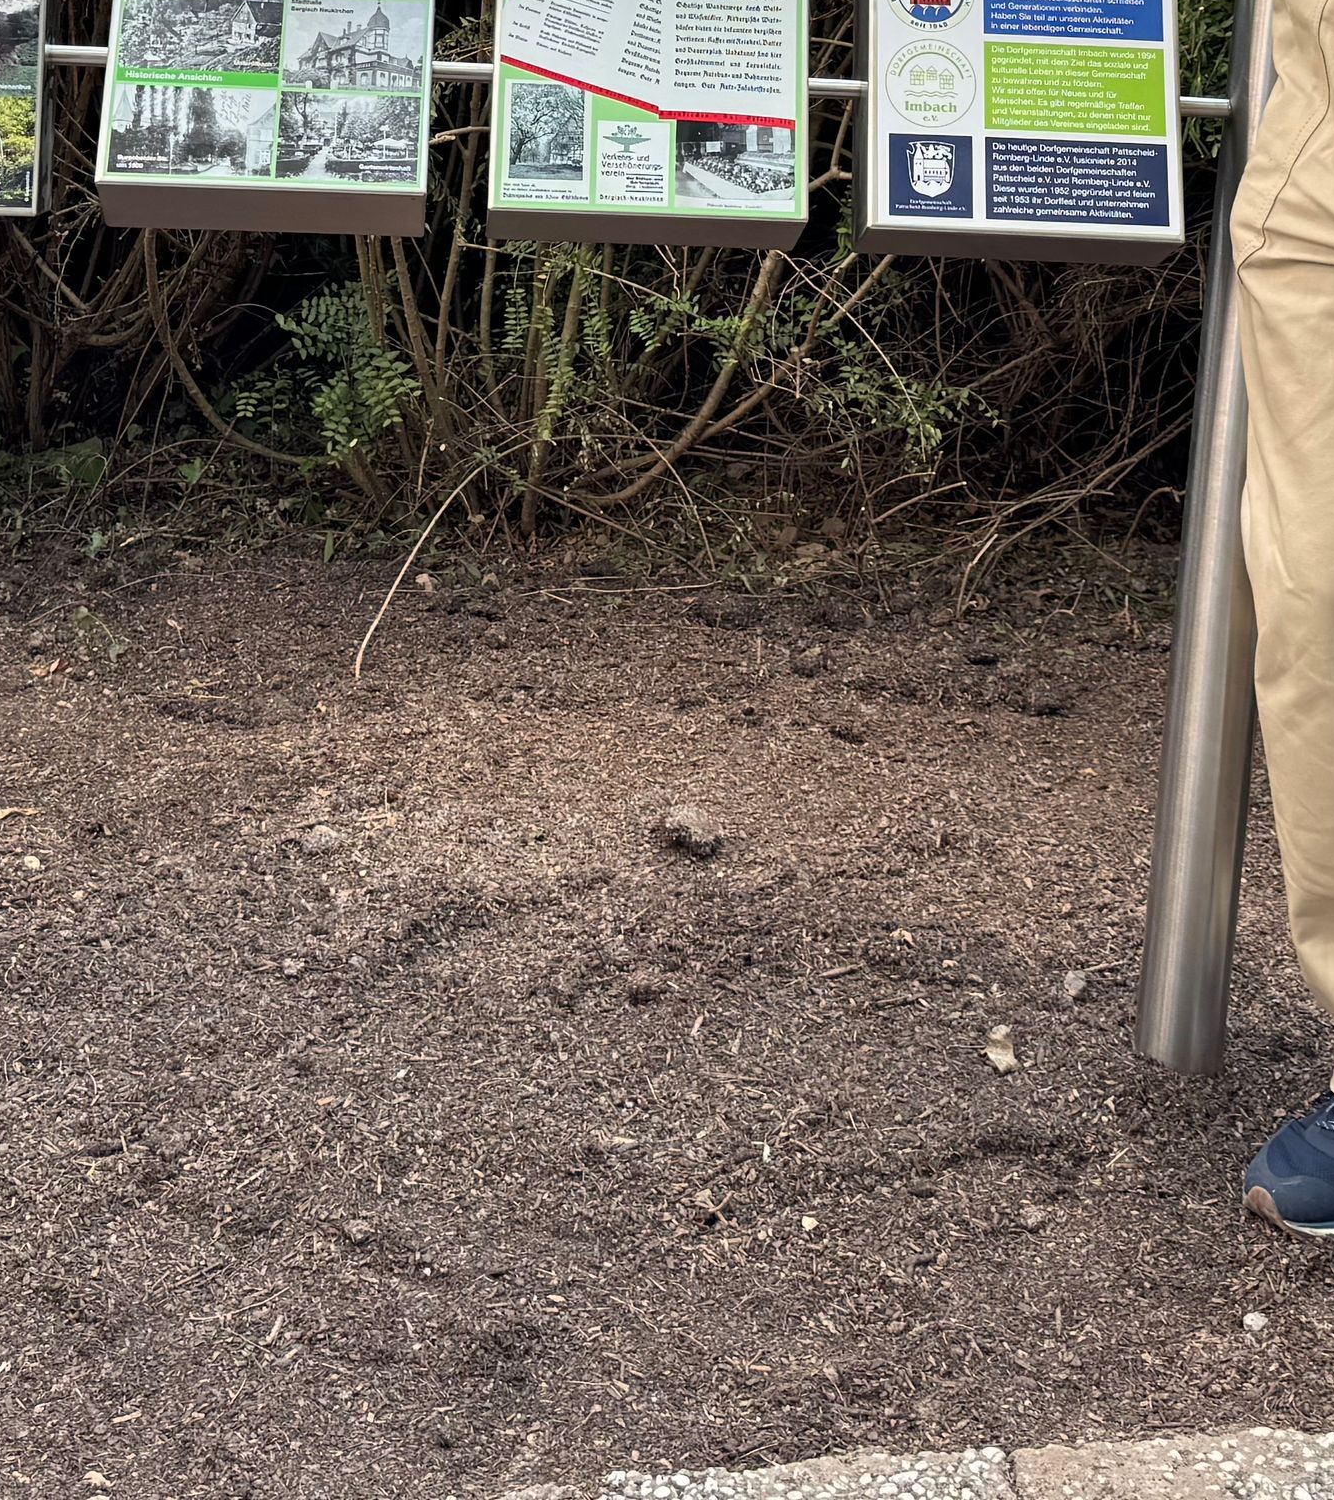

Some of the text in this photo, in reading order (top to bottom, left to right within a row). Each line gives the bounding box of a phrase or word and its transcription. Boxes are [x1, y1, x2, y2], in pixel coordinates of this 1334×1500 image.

[125, 70, 223, 82] Historische Ansichten
[904, 100, 957, 113] Imbach
[992, 142, 1158, 157] Die heutige Dorfgemeinschaft Pattscheid-
[992, 153, 1055, 163] Romberg-Linde
[1073, 156, 1115, 165] fusionierte
[1117, 157, 1137, 166] 2014
[1009, 163, 1025, 172] den
[1026, 165, 1054, 173] beiden
[1056, 165, 1137, 176] Dorfgemeinschaften
[993, 173, 1036, 183] Pattscheid
[1053, 176, 1069, 184] und
[1071, 177, 1134, 187] Romberg-Linde
[993, 184, 1156, 199] Diese wurden 1952 gegründet und feiern
[993, 195, 1149, 209] seit 1953 ihr Dorffest und unternehmen
[993, 205, 1134, 219] zahlreiche gemeinsame Aktivitäten.
